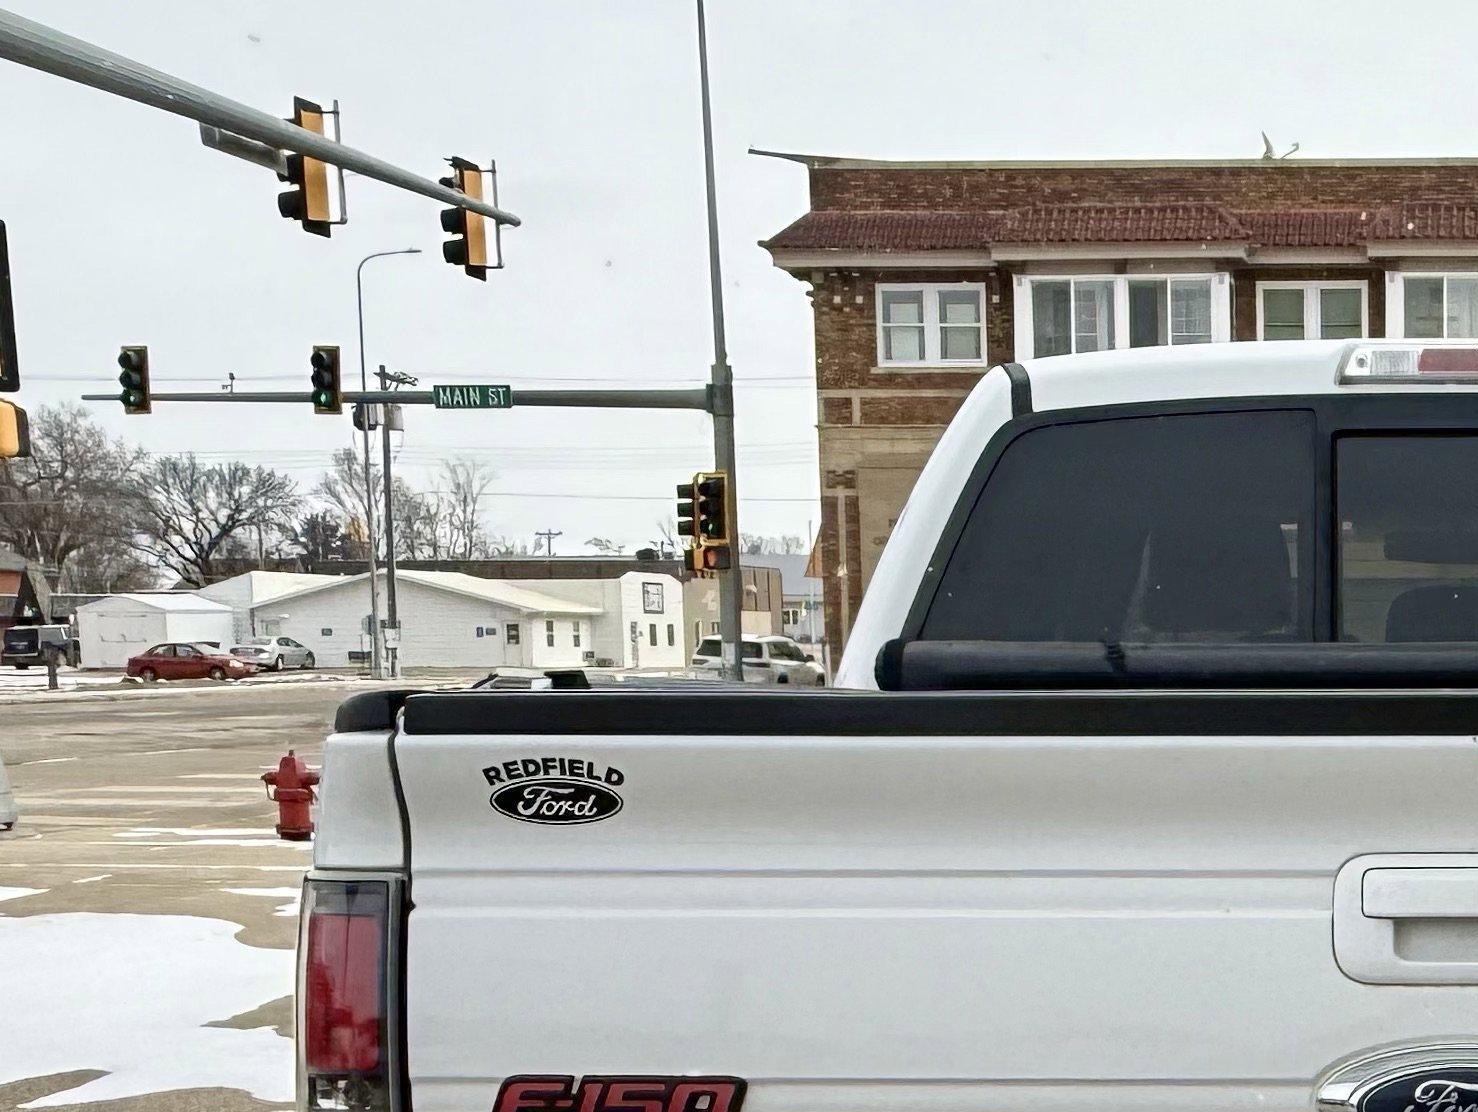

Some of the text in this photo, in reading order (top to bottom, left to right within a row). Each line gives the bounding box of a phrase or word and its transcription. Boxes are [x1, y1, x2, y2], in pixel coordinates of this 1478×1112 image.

[439, 386, 507, 407] MAIN ST
[482, 757, 625, 787] REDFIELD
[517, 786, 598, 816] Ford
